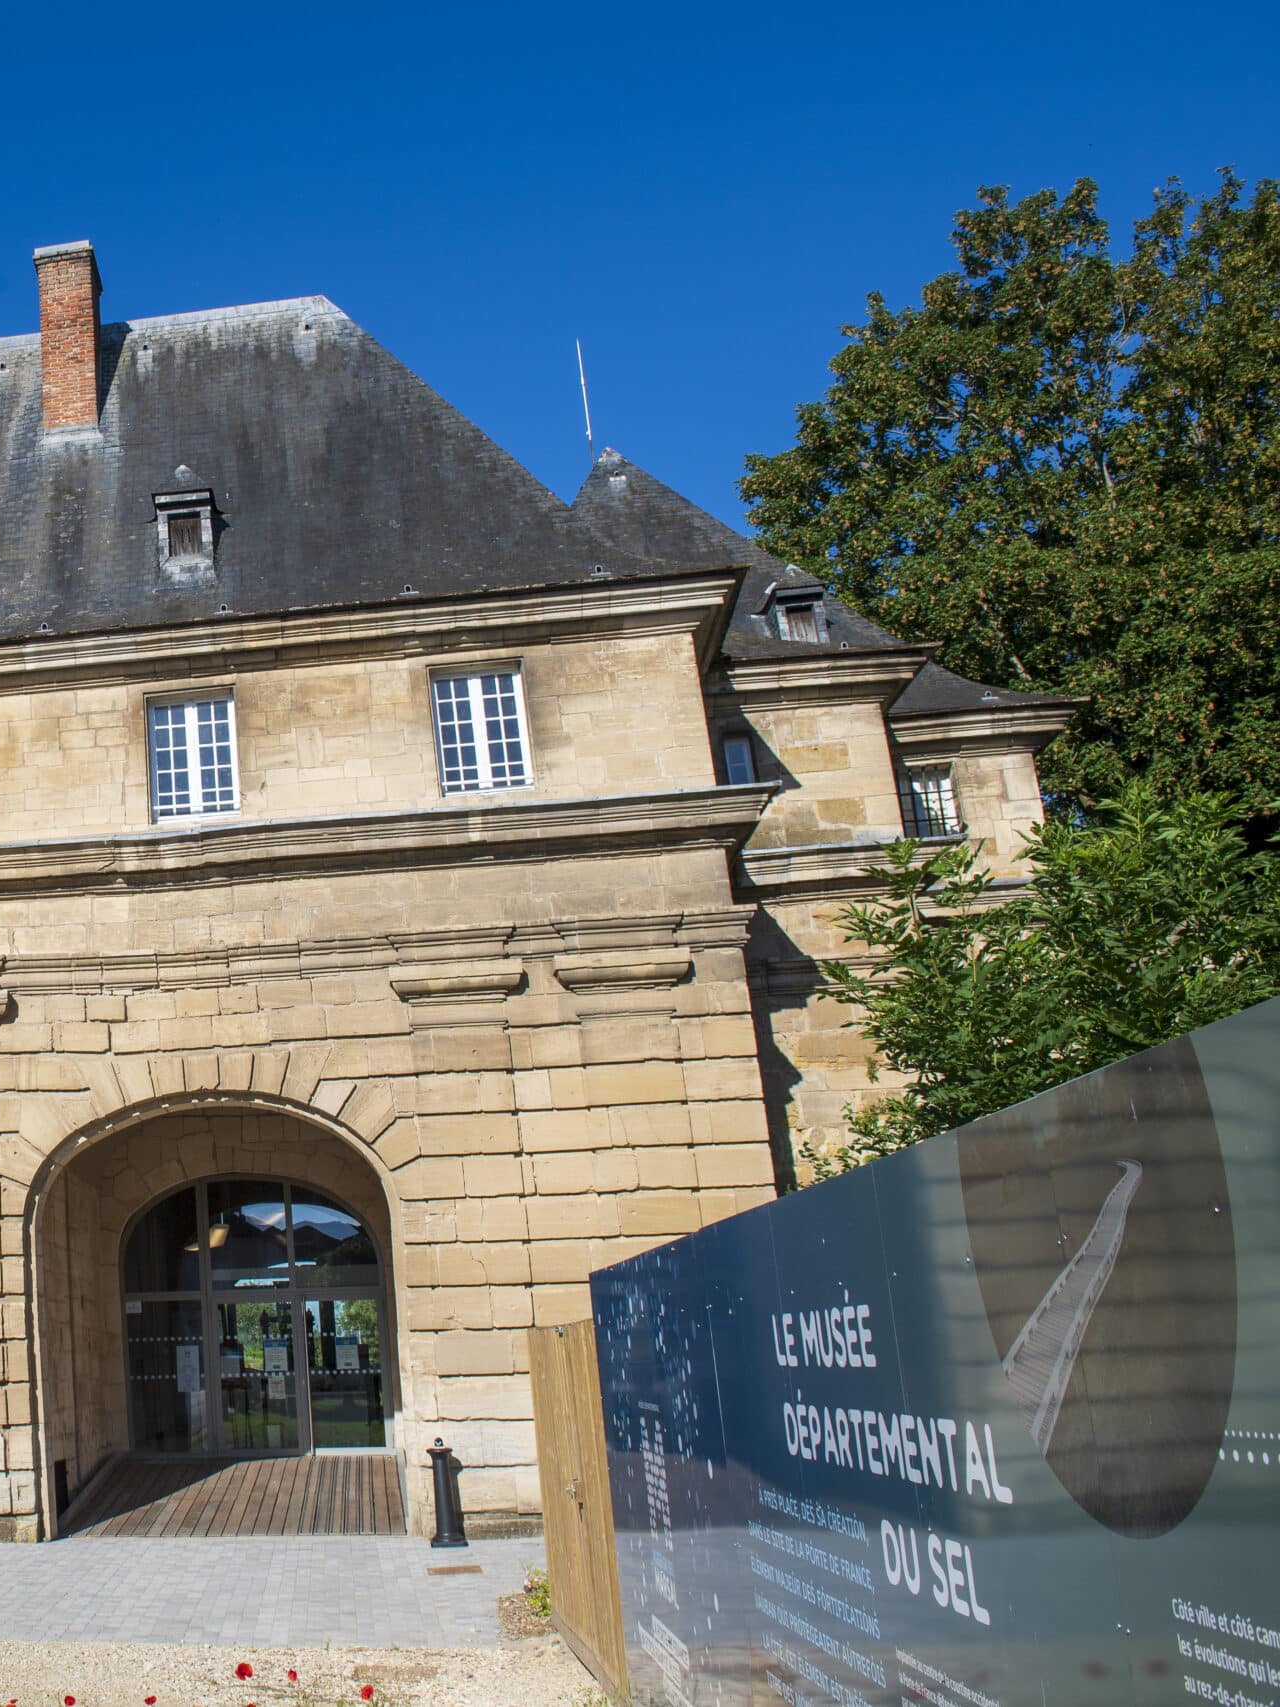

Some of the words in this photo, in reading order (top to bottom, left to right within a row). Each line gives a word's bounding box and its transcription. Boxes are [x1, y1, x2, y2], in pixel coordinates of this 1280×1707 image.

[772, 1312, 798, 1367] LE
[799, 1289, 877, 1368] MUSÉE
[783, 1389, 1013, 1505] DÉPARTEMENTAL
[827, 1504, 869, 1547] CRÉATION,
[785, 1533, 795, 1556] DE
[795, 1538, 804, 1559] LA
[804, 1540, 829, 1571] PORTE
[829, 1552, 840, 1577] DE
[840, 1558, 876, 1595] FRANCE,
[881, 1519, 921, 1596] DU
[927, 1531, 991, 1626] SEL
[816, 1585, 881, 1641] FORTIFICATIONS
[1172, 1597, 1195, 1623] Côté
[1195, 1604, 1217, 1630] ville
[1218, 1613, 1230, 1634] et
[1230, 1614, 1255, 1641] côté
[1256, 1626, 1280, 1649] cam
[842, 1640, 888, 1689] AUTREFOIS
[1177, 1632, 1193, 1657] les
[1194, 1637, 1248, 1677] évolutions
[1248, 1659, 1267, 1685] qui
[1184, 1675, 1197, 1694] au
